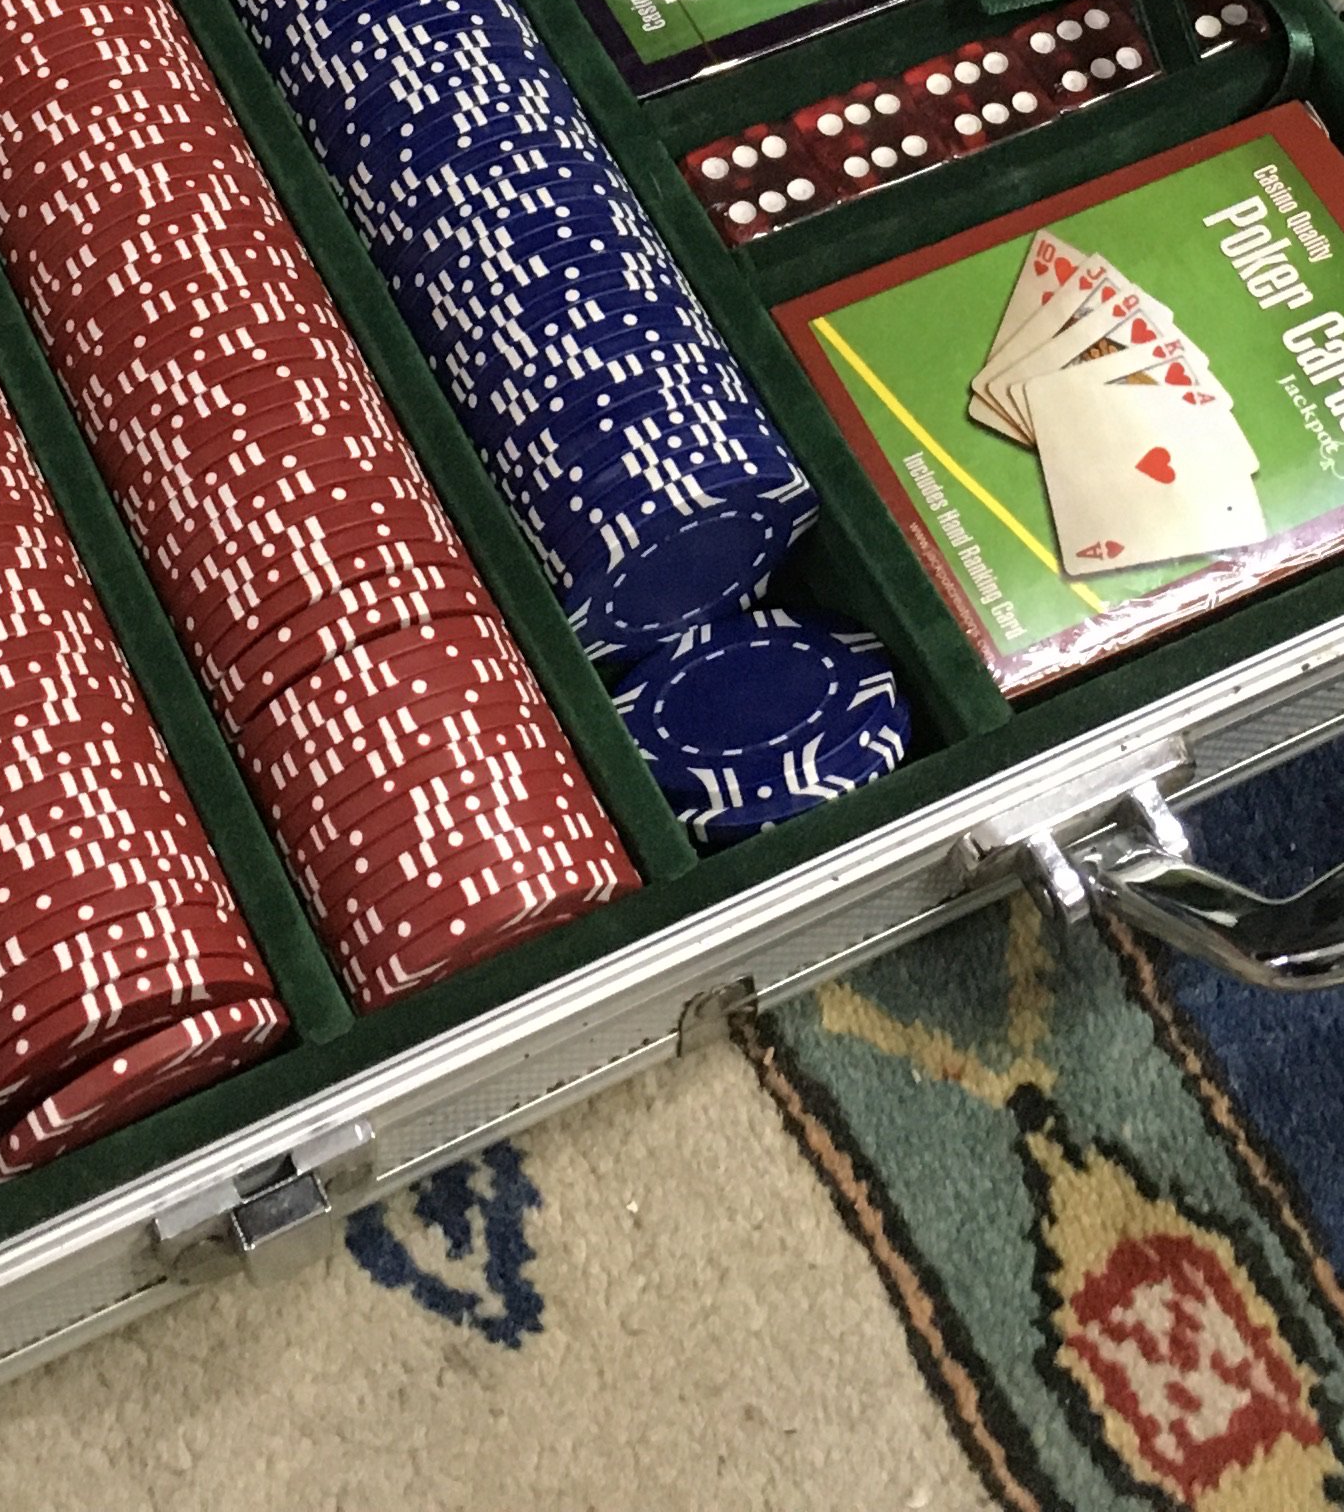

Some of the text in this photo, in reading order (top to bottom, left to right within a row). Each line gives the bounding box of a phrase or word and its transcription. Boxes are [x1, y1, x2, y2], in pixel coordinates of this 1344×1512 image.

[1253, 164, 1333, 263] Casino Quality
[1036, 240, 1056, 263] 10
[1202, 195, 1314, 310] Poker
[1087, 266, 1106, 280] J
[1122, 294, 1140, 311] Q
[1164, 339, 1185, 356] K
[1197, 392, 1216, 405] A
[903, 451, 1028, 640] Includes Hand Ranking Card
[1076, 541, 1103, 560] A
